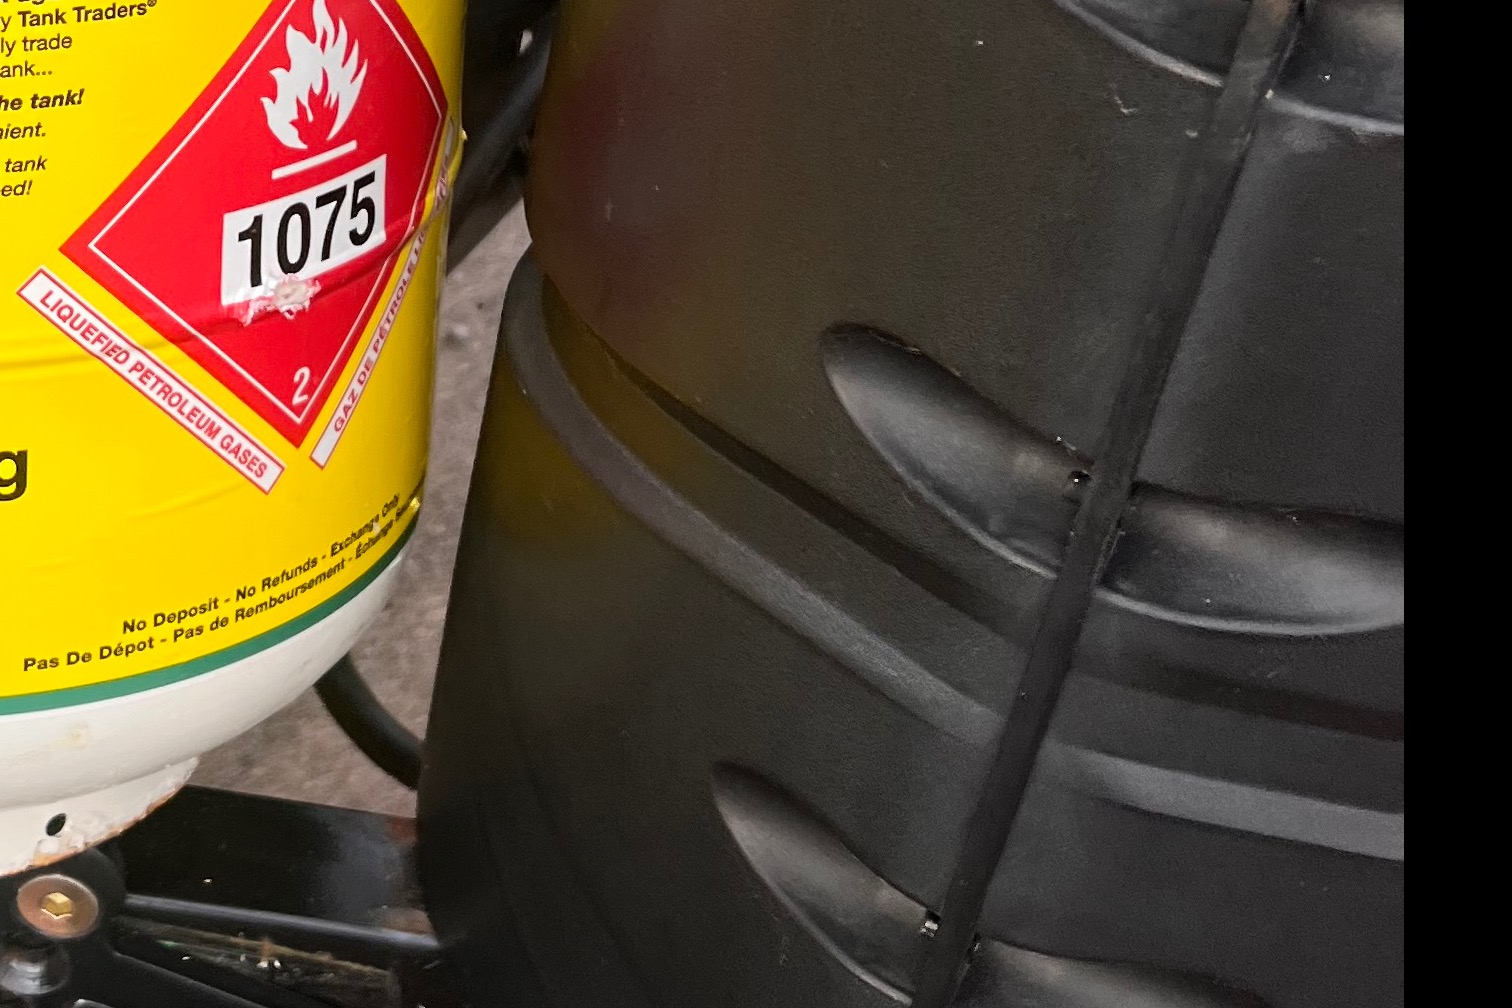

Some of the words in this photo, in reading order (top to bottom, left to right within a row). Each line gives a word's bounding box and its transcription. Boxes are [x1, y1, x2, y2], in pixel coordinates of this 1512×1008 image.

[18, 8, 67, 27] Tank
[22, 33, 72, 51] trade
[30, 88, 85, 109] tank!
[5, 155, 47, 172] tank
[237, 171, 376, 288] 1075
[39, 290, 130, 366] LIQUEFIED
[128, 359, 221, 440] PETROLEUM
[219, 434, 268, 478] GASES
[292, 366, 311, 406] 2
[334, 389, 357, 432] GAZ
[357, 357, 372, 386] DE
[24, 658, 59, 671] Pas
[67, 652, 92, 665] De
[100, 637, 154, 660] Dépot
[174, 626, 203, 642] Pas
[210, 616, 229, 631] de
[235, 557, 346, 623] Remboursement
[123, 619, 146, 634] No
[154, 597, 219, 627] Deposit
[236, 586, 256, 602] No
[262, 557, 317, 592] Refunds
